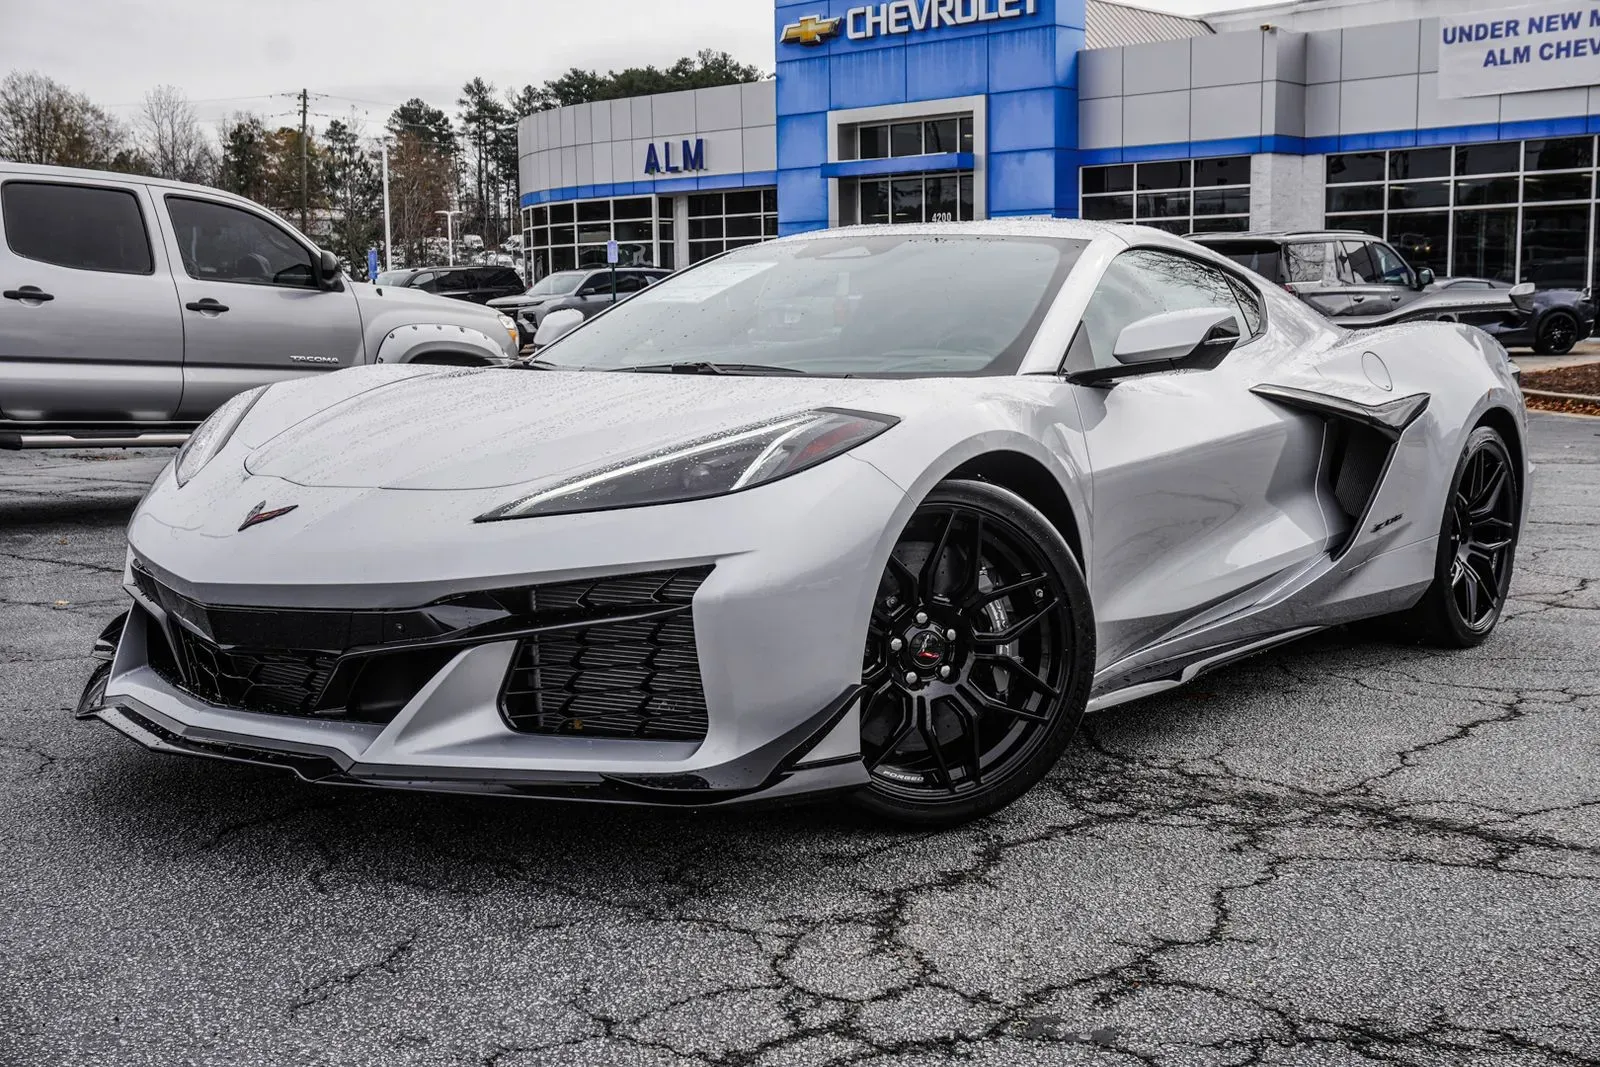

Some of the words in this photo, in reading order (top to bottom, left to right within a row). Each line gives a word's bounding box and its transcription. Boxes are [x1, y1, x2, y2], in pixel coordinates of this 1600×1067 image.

[1442, 19, 1520, 45] UNDER
[1527, 11, 1583, 35] NEW
[1483, 45, 1531, 67] ALM
[644, 138, 706, 174] ALM
[931, 212, 952, 222] 4200
[289, 355, 339, 363] TACOMA
[883, 770, 925, 782] FORGED
